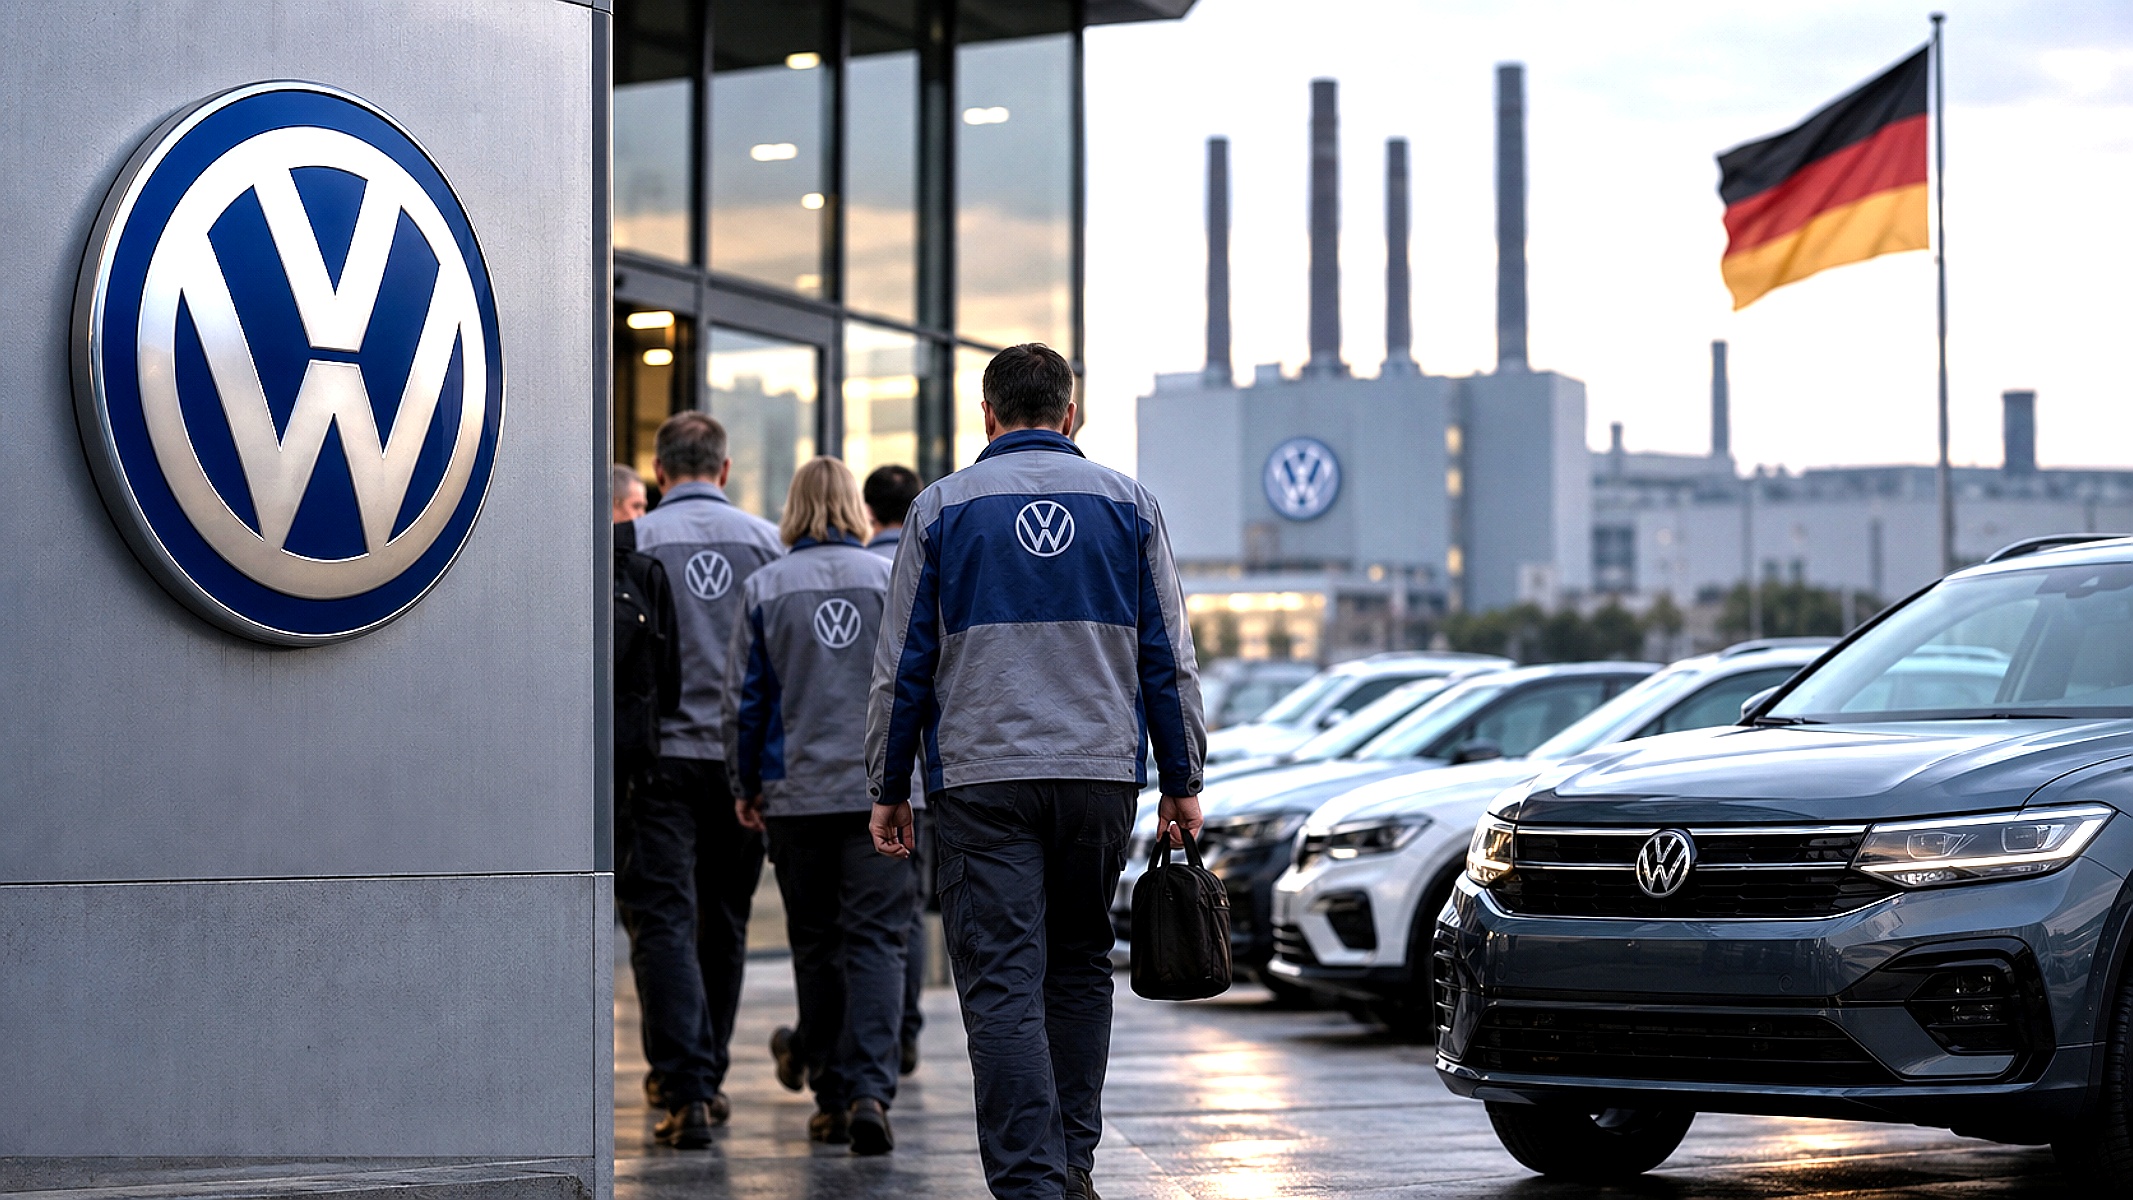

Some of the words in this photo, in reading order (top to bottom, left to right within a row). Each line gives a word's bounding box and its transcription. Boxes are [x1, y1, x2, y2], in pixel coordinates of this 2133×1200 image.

[144, 132, 484, 592] VW
[1270, 443, 1334, 514] VW
[1017, 502, 1072, 554] VW
[687, 552, 731, 598] VW
[815, 600, 859, 647] VW
[1638, 833, 1688, 895] VW
